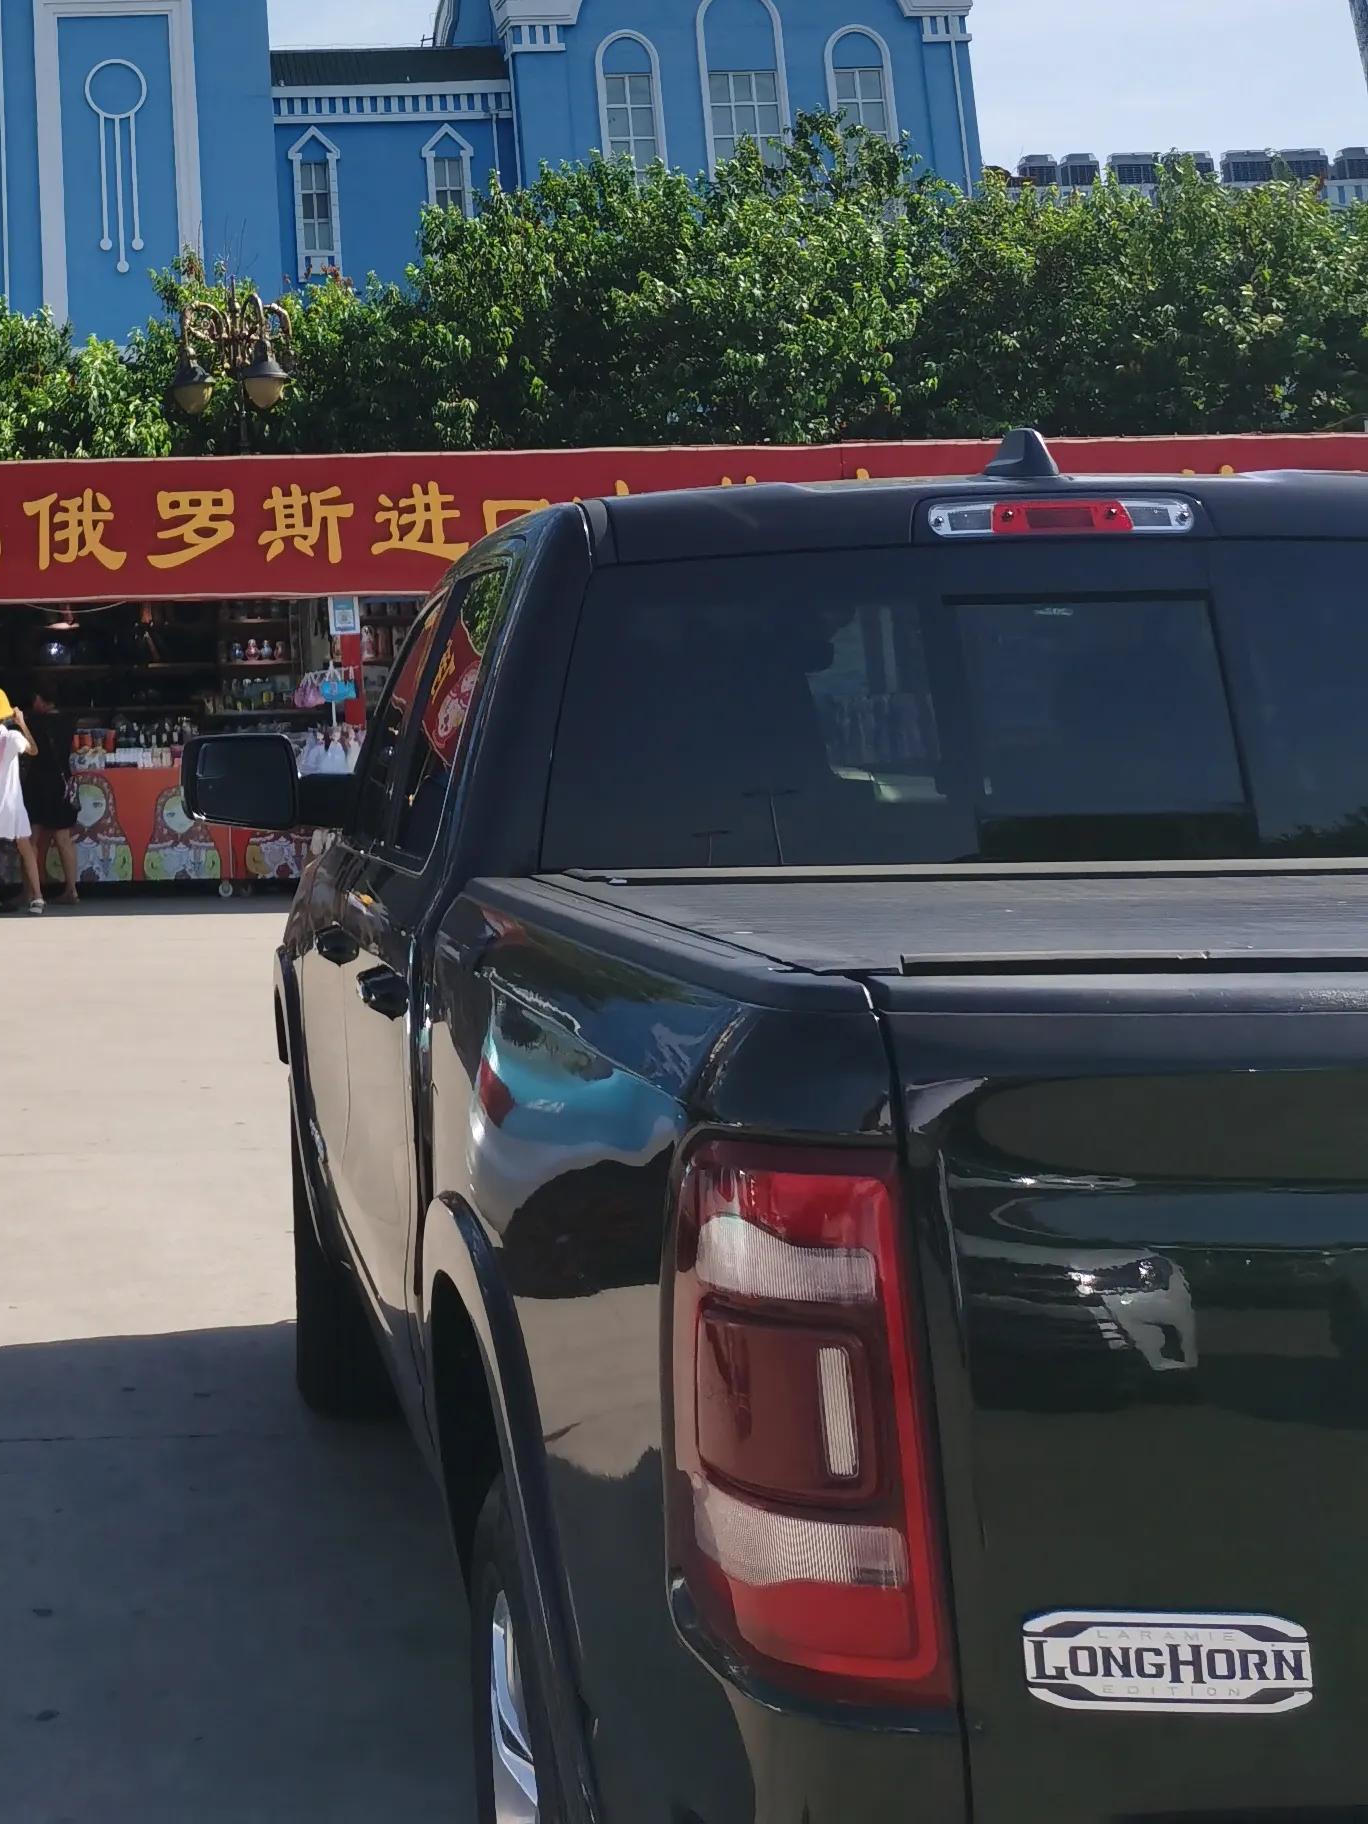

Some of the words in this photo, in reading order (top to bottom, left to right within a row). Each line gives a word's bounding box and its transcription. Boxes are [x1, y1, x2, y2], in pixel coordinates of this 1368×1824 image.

[1096, 1629, 1236, 1641] LARAMIE
[1029, 1640, 1309, 1684] LONGHORN
[1101, 1683, 1241, 1697] EDITION
